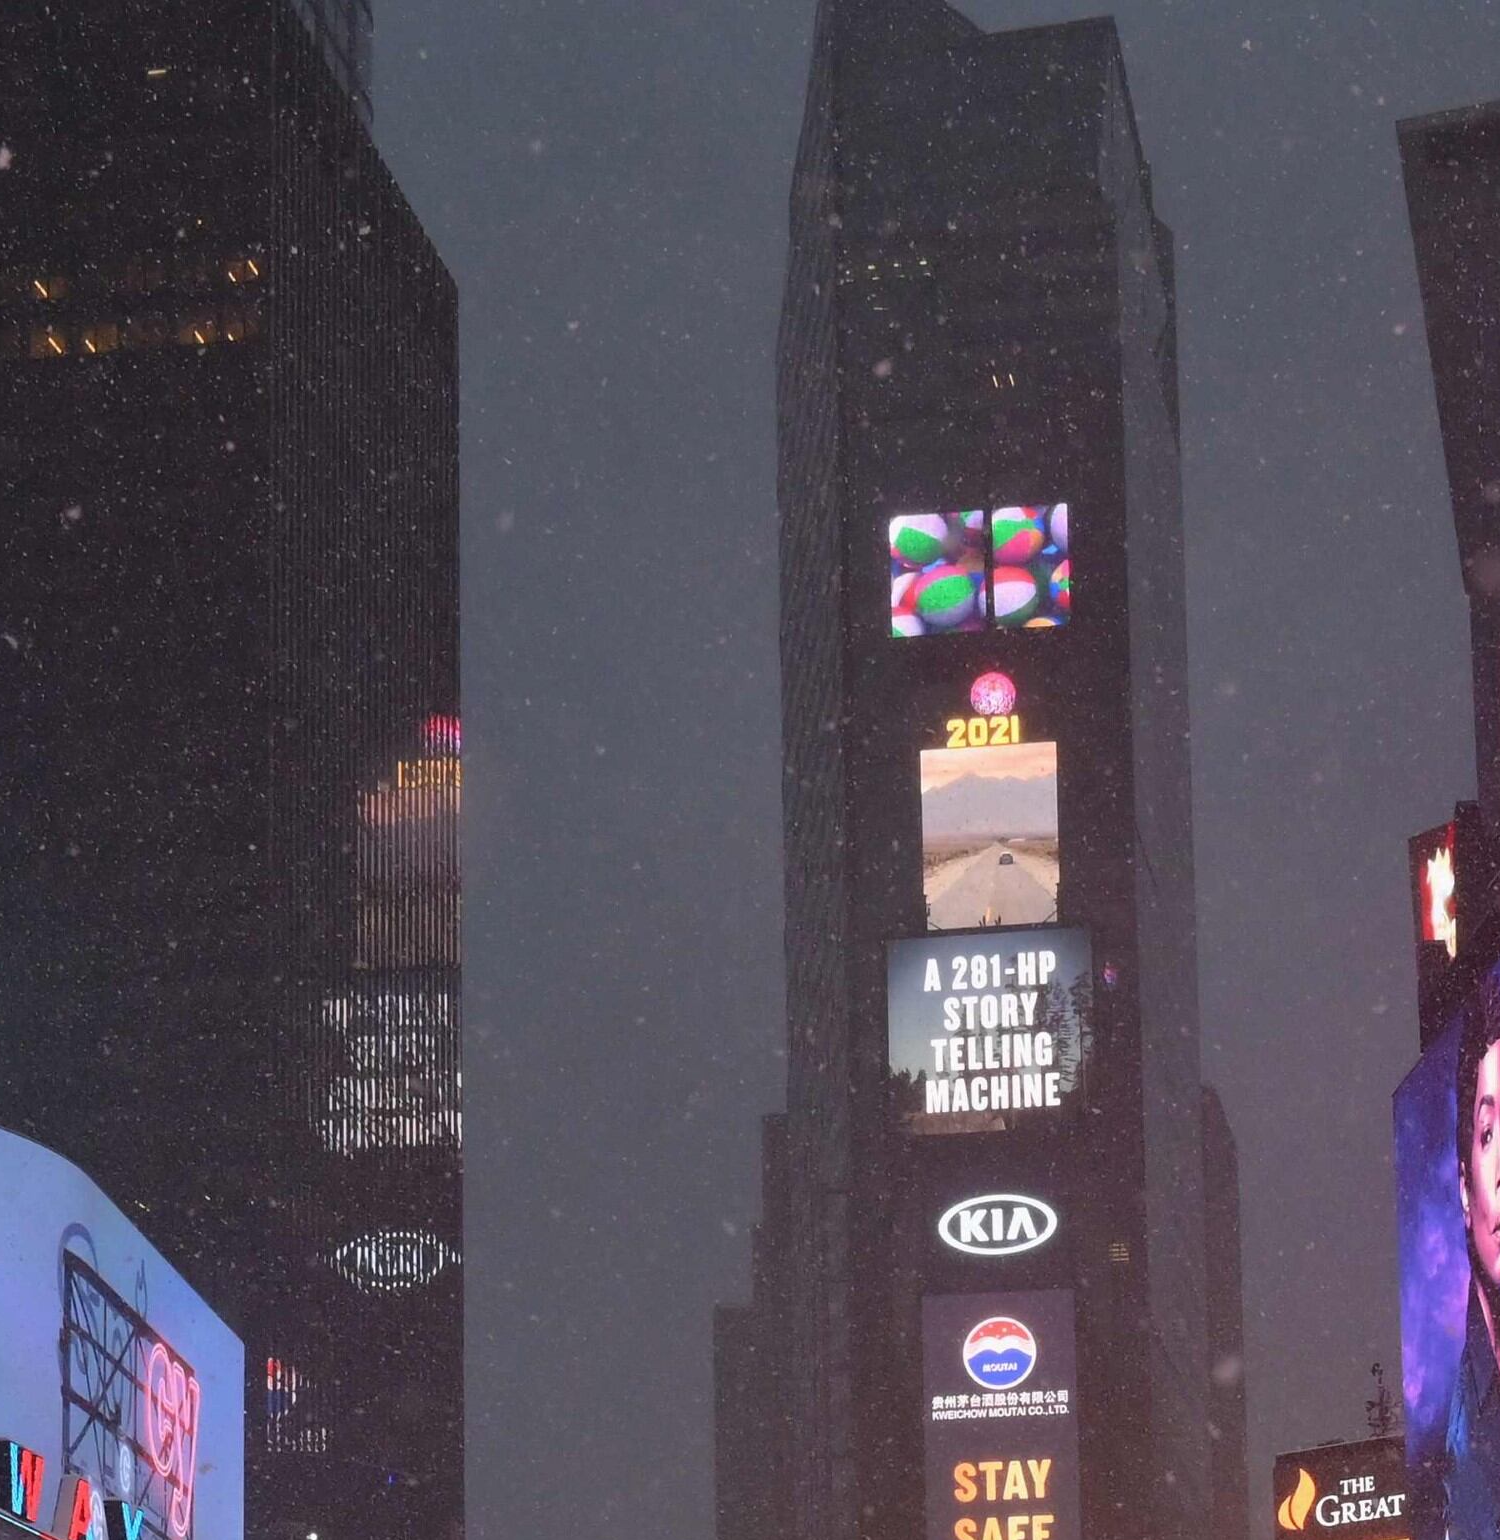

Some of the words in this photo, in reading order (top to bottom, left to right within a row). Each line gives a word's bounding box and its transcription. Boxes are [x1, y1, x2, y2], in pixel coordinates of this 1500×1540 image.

[946, 715, 1020, 748] 2021
[924, 958, 941, 992] A
[951, 951, 1056, 990] 281-HP
[944, 992, 1038, 1031] STORY
[930, 1031, 1053, 1072] TELLING
[925, 1072, 1061, 1114] MACHINE
[959, 1207, 1038, 1243] KIA
[932, 1408, 988, 1421] KWEICHOW
[988, 1406, 1027, 1418] MOUTAI
[954, 1459, 1051, 1503] STAY
[1339, 1475, 1375, 1496] THE
